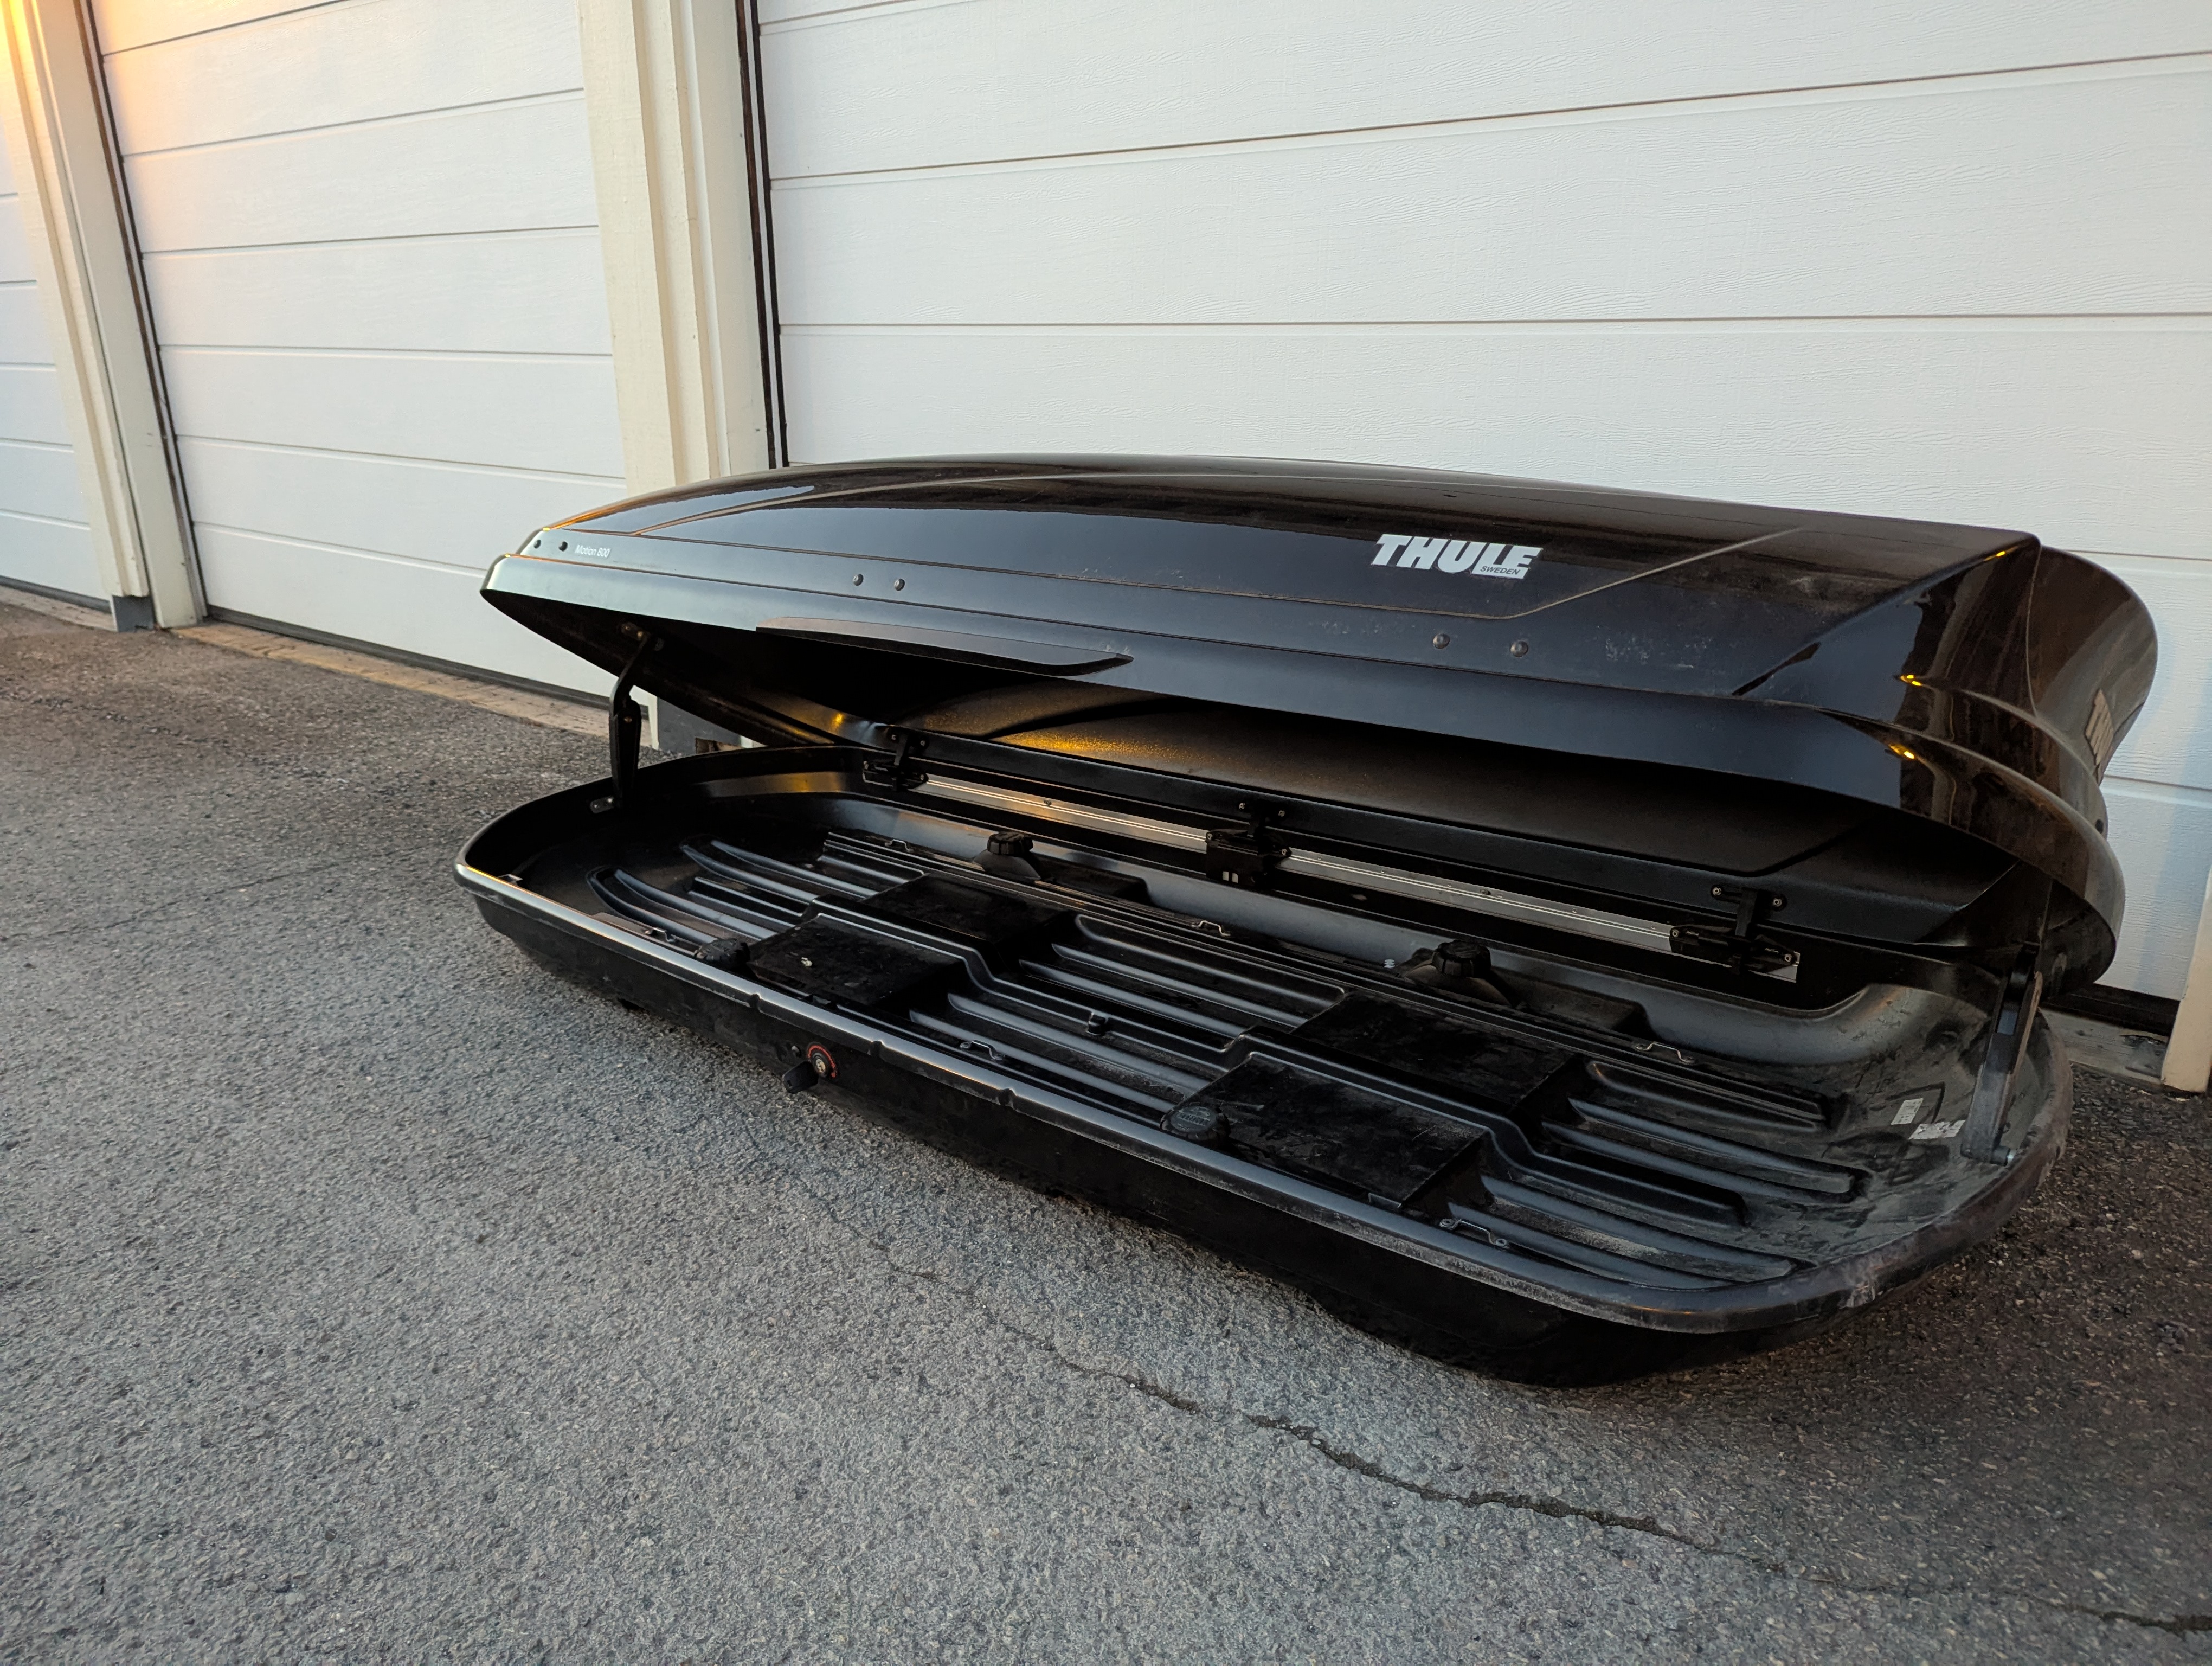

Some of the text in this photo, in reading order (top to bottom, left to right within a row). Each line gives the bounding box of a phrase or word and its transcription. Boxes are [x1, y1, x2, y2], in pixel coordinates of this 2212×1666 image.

[575, 544, 597, 556] Motion
[1371, 534, 1544, 579] THULE
[1480, 566, 1520, 575] SWEDEN
